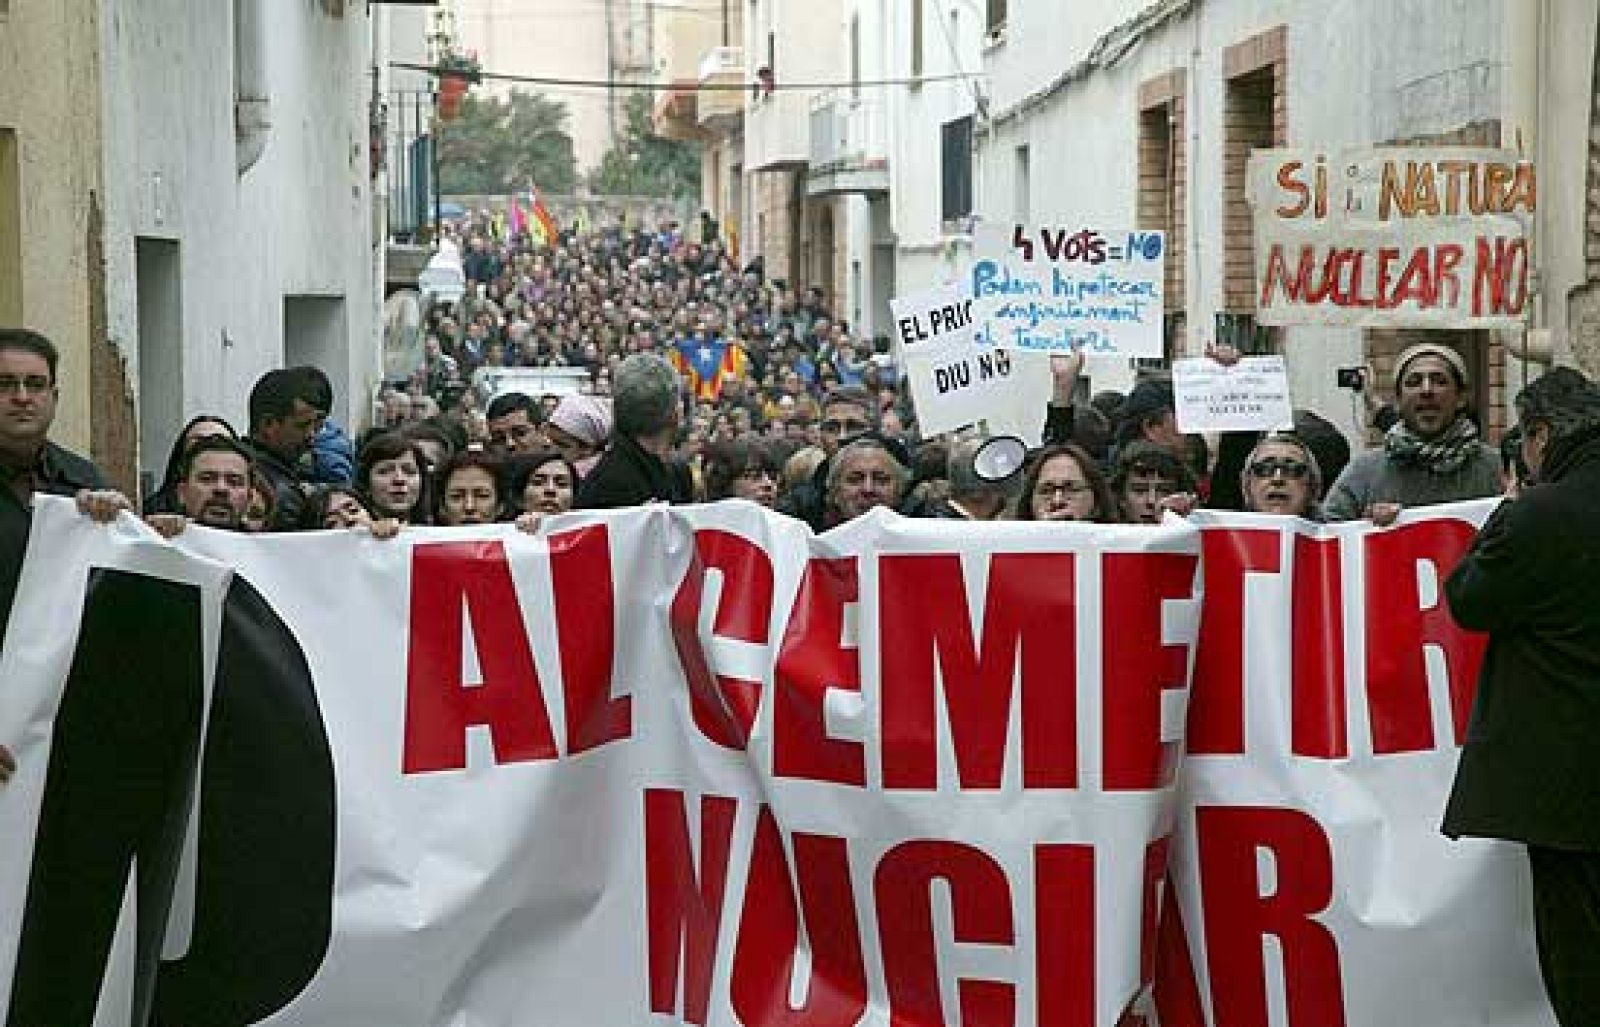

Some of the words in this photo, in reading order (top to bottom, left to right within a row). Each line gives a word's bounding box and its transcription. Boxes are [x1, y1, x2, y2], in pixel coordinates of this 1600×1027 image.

[1261, 243, 1464, 310] NUCLEAR
[1471, 235, 1529, 318] NO
[899, 314, 929, 344] EL
[935, 360, 970, 394] DIU
[402, 523, 632, 774] AL
